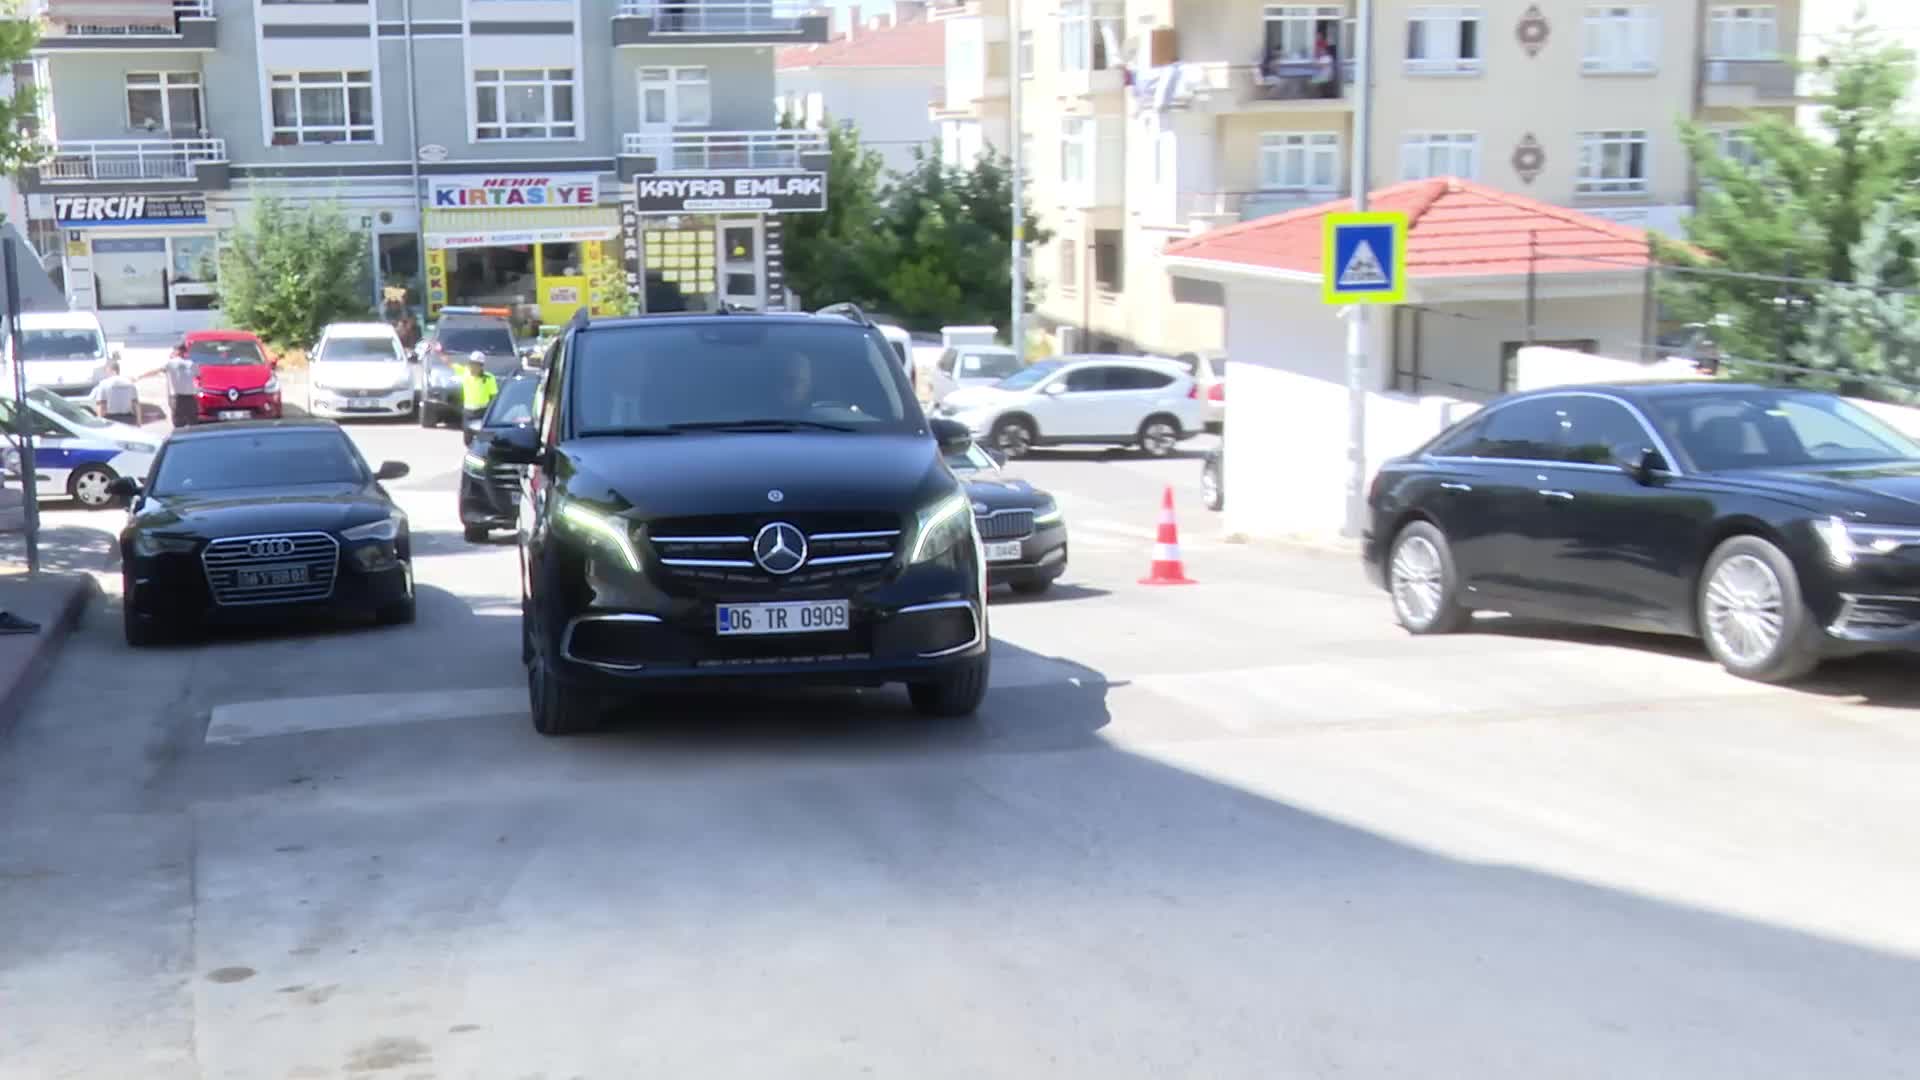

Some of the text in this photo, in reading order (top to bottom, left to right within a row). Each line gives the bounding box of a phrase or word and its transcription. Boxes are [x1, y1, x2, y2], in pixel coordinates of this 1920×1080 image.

[734, 177, 821, 196] EMLAK
[730, 605, 845, 630] 06 TR 0909
